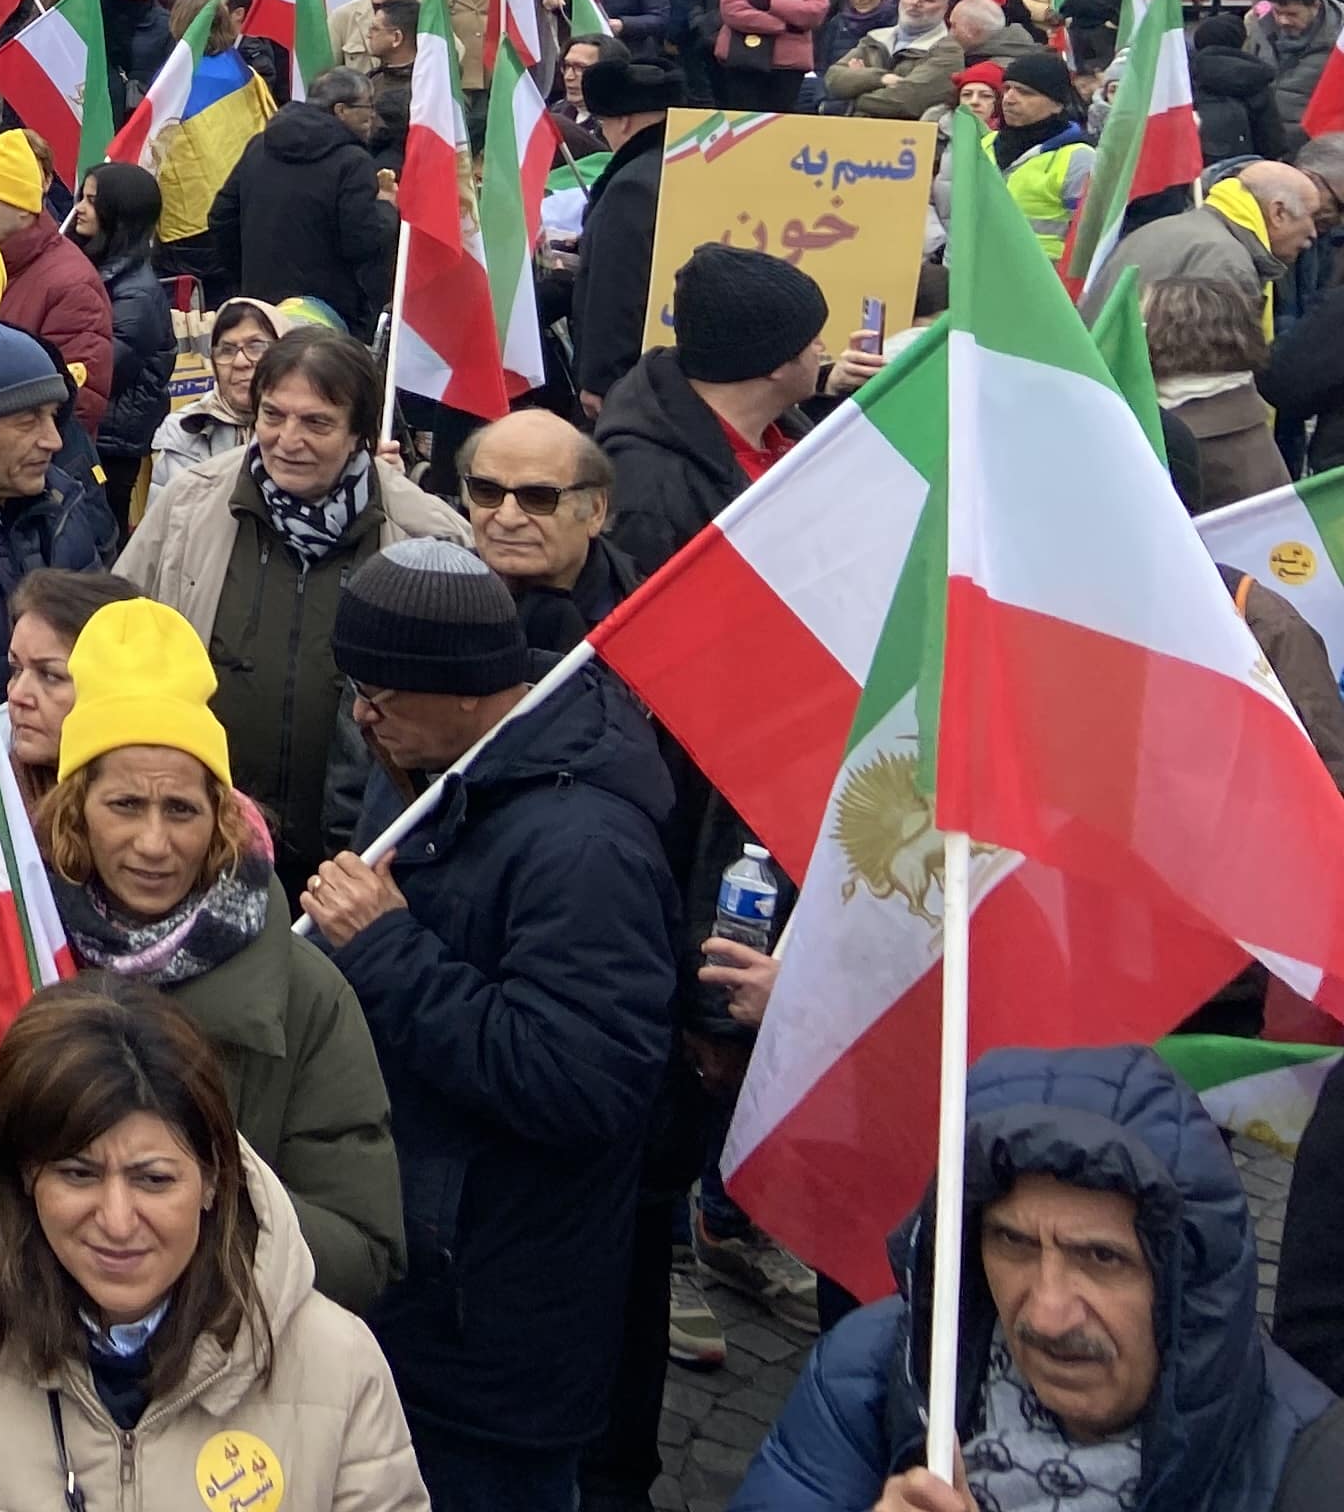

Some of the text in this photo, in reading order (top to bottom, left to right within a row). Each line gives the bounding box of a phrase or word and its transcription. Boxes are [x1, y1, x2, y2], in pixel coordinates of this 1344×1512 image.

[789, 139, 917, 191] قسم به
[720, 194, 860, 266] خون
[206, 1459, 247, 1499] شاه
